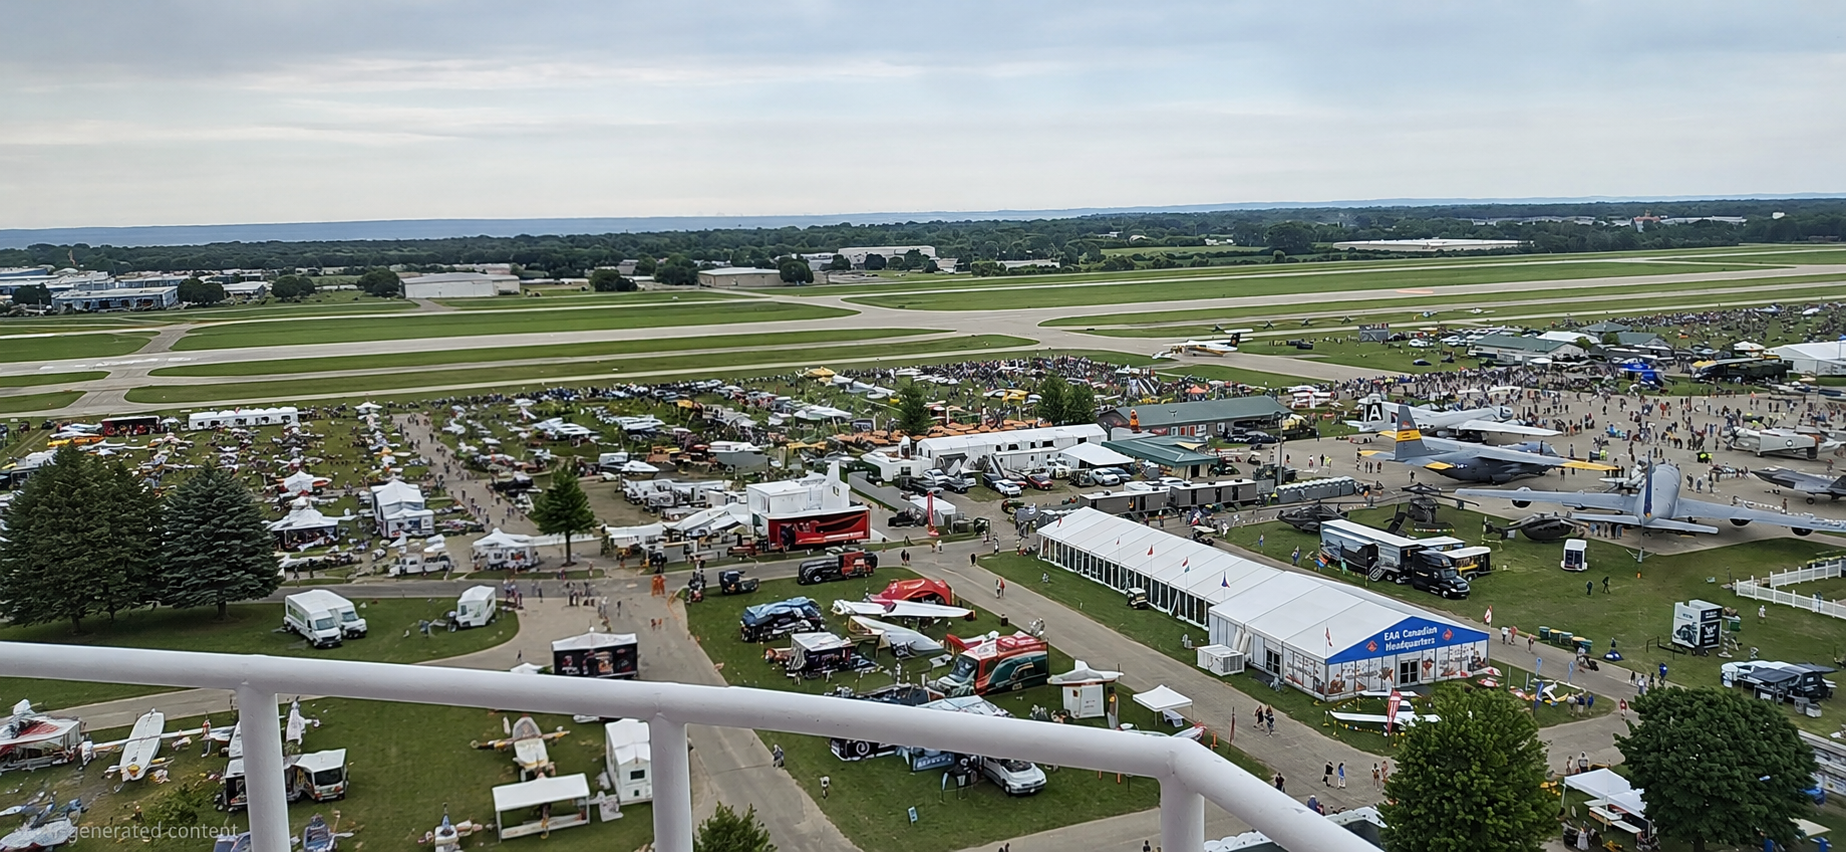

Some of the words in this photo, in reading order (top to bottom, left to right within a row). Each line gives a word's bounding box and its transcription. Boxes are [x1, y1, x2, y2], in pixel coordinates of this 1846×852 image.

[1368, 404, 1382, 421] A
[1384, 631, 1400, 641] EAA
[1402, 626, 1438, 638] Canadian
[1385, 637, 1436, 651] Headquarters
